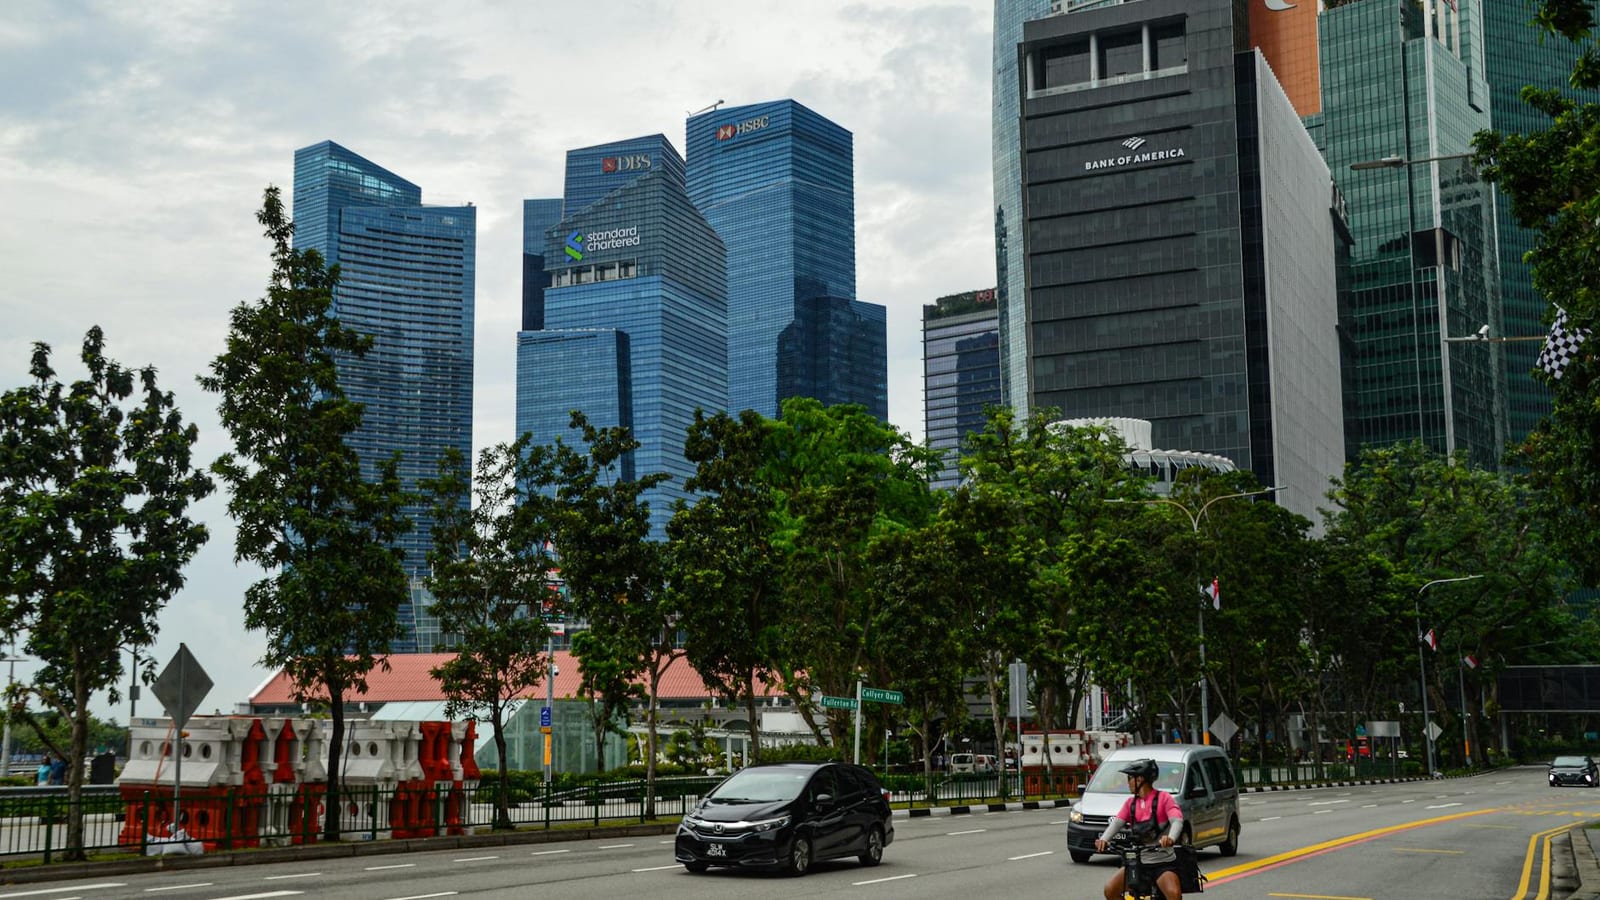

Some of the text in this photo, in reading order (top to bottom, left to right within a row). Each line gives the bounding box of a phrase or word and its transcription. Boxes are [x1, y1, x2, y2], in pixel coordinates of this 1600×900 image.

[736, 115, 769, 135] HSBC
[617, 154, 652, 171] DBS
[1085, 147, 1185, 170] BANK OF AMERICA
[587, 225, 637, 242] standard
[587, 233, 640, 252] chartered
[823, 698, 849, 707] Fullerton
[862, 689, 900, 702] Collyer Quay
